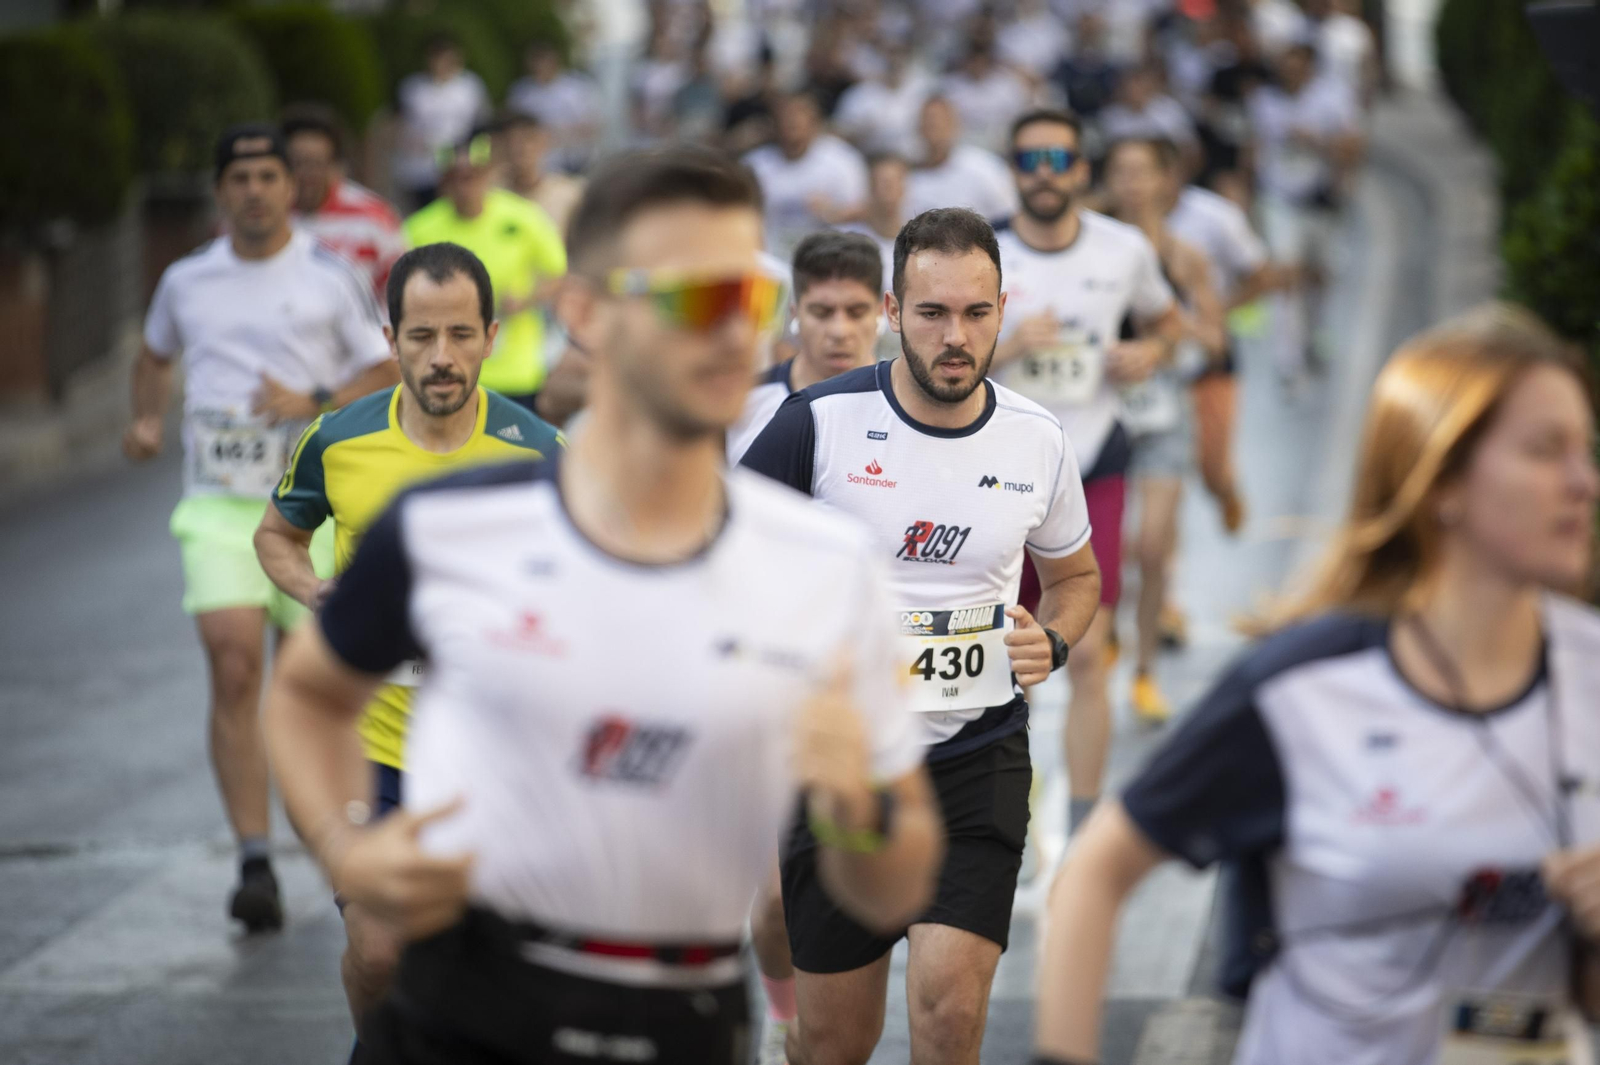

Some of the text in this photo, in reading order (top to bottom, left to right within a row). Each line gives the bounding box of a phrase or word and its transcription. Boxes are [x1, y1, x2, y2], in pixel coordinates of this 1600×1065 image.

[847, 473, 897, 488] Santander
[1004, 482, 1034, 494] mupol
[947, 605, 996, 630] GRANADA
[909, 643, 984, 681] 430
[942, 685, 959, 697] IVÁN
